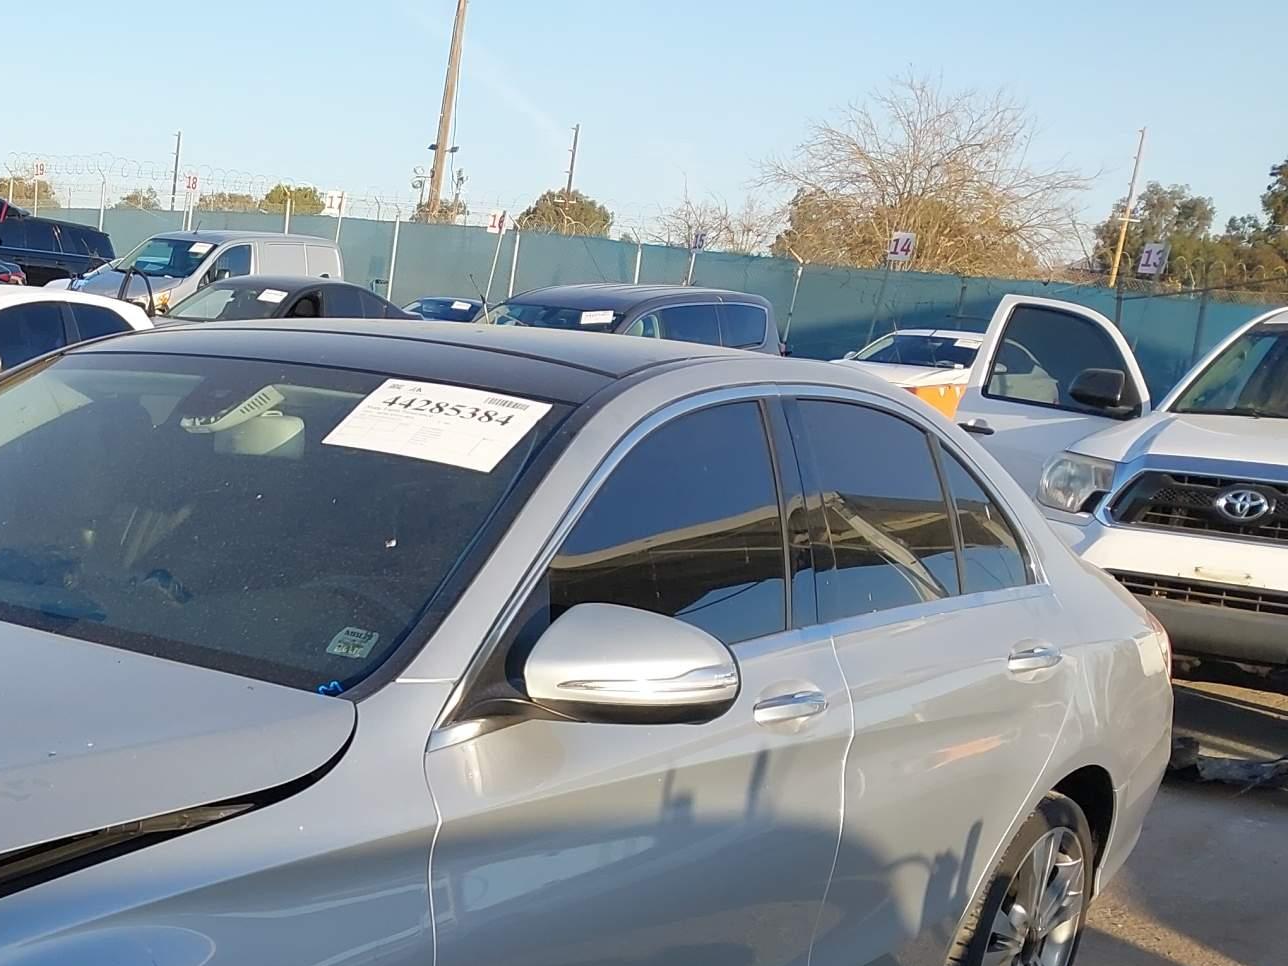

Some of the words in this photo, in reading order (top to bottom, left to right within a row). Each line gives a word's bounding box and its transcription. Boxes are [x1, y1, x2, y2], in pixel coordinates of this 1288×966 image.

[34, 163, 44, 175] 19
[185, 175, 198, 190] 18
[326, 195, 343, 209] 17
[692, 233, 706, 249] 15
[889, 238, 912, 256] 14
[1141, 249, 1164, 268] 13
[382, 395, 514, 426] 44285384
